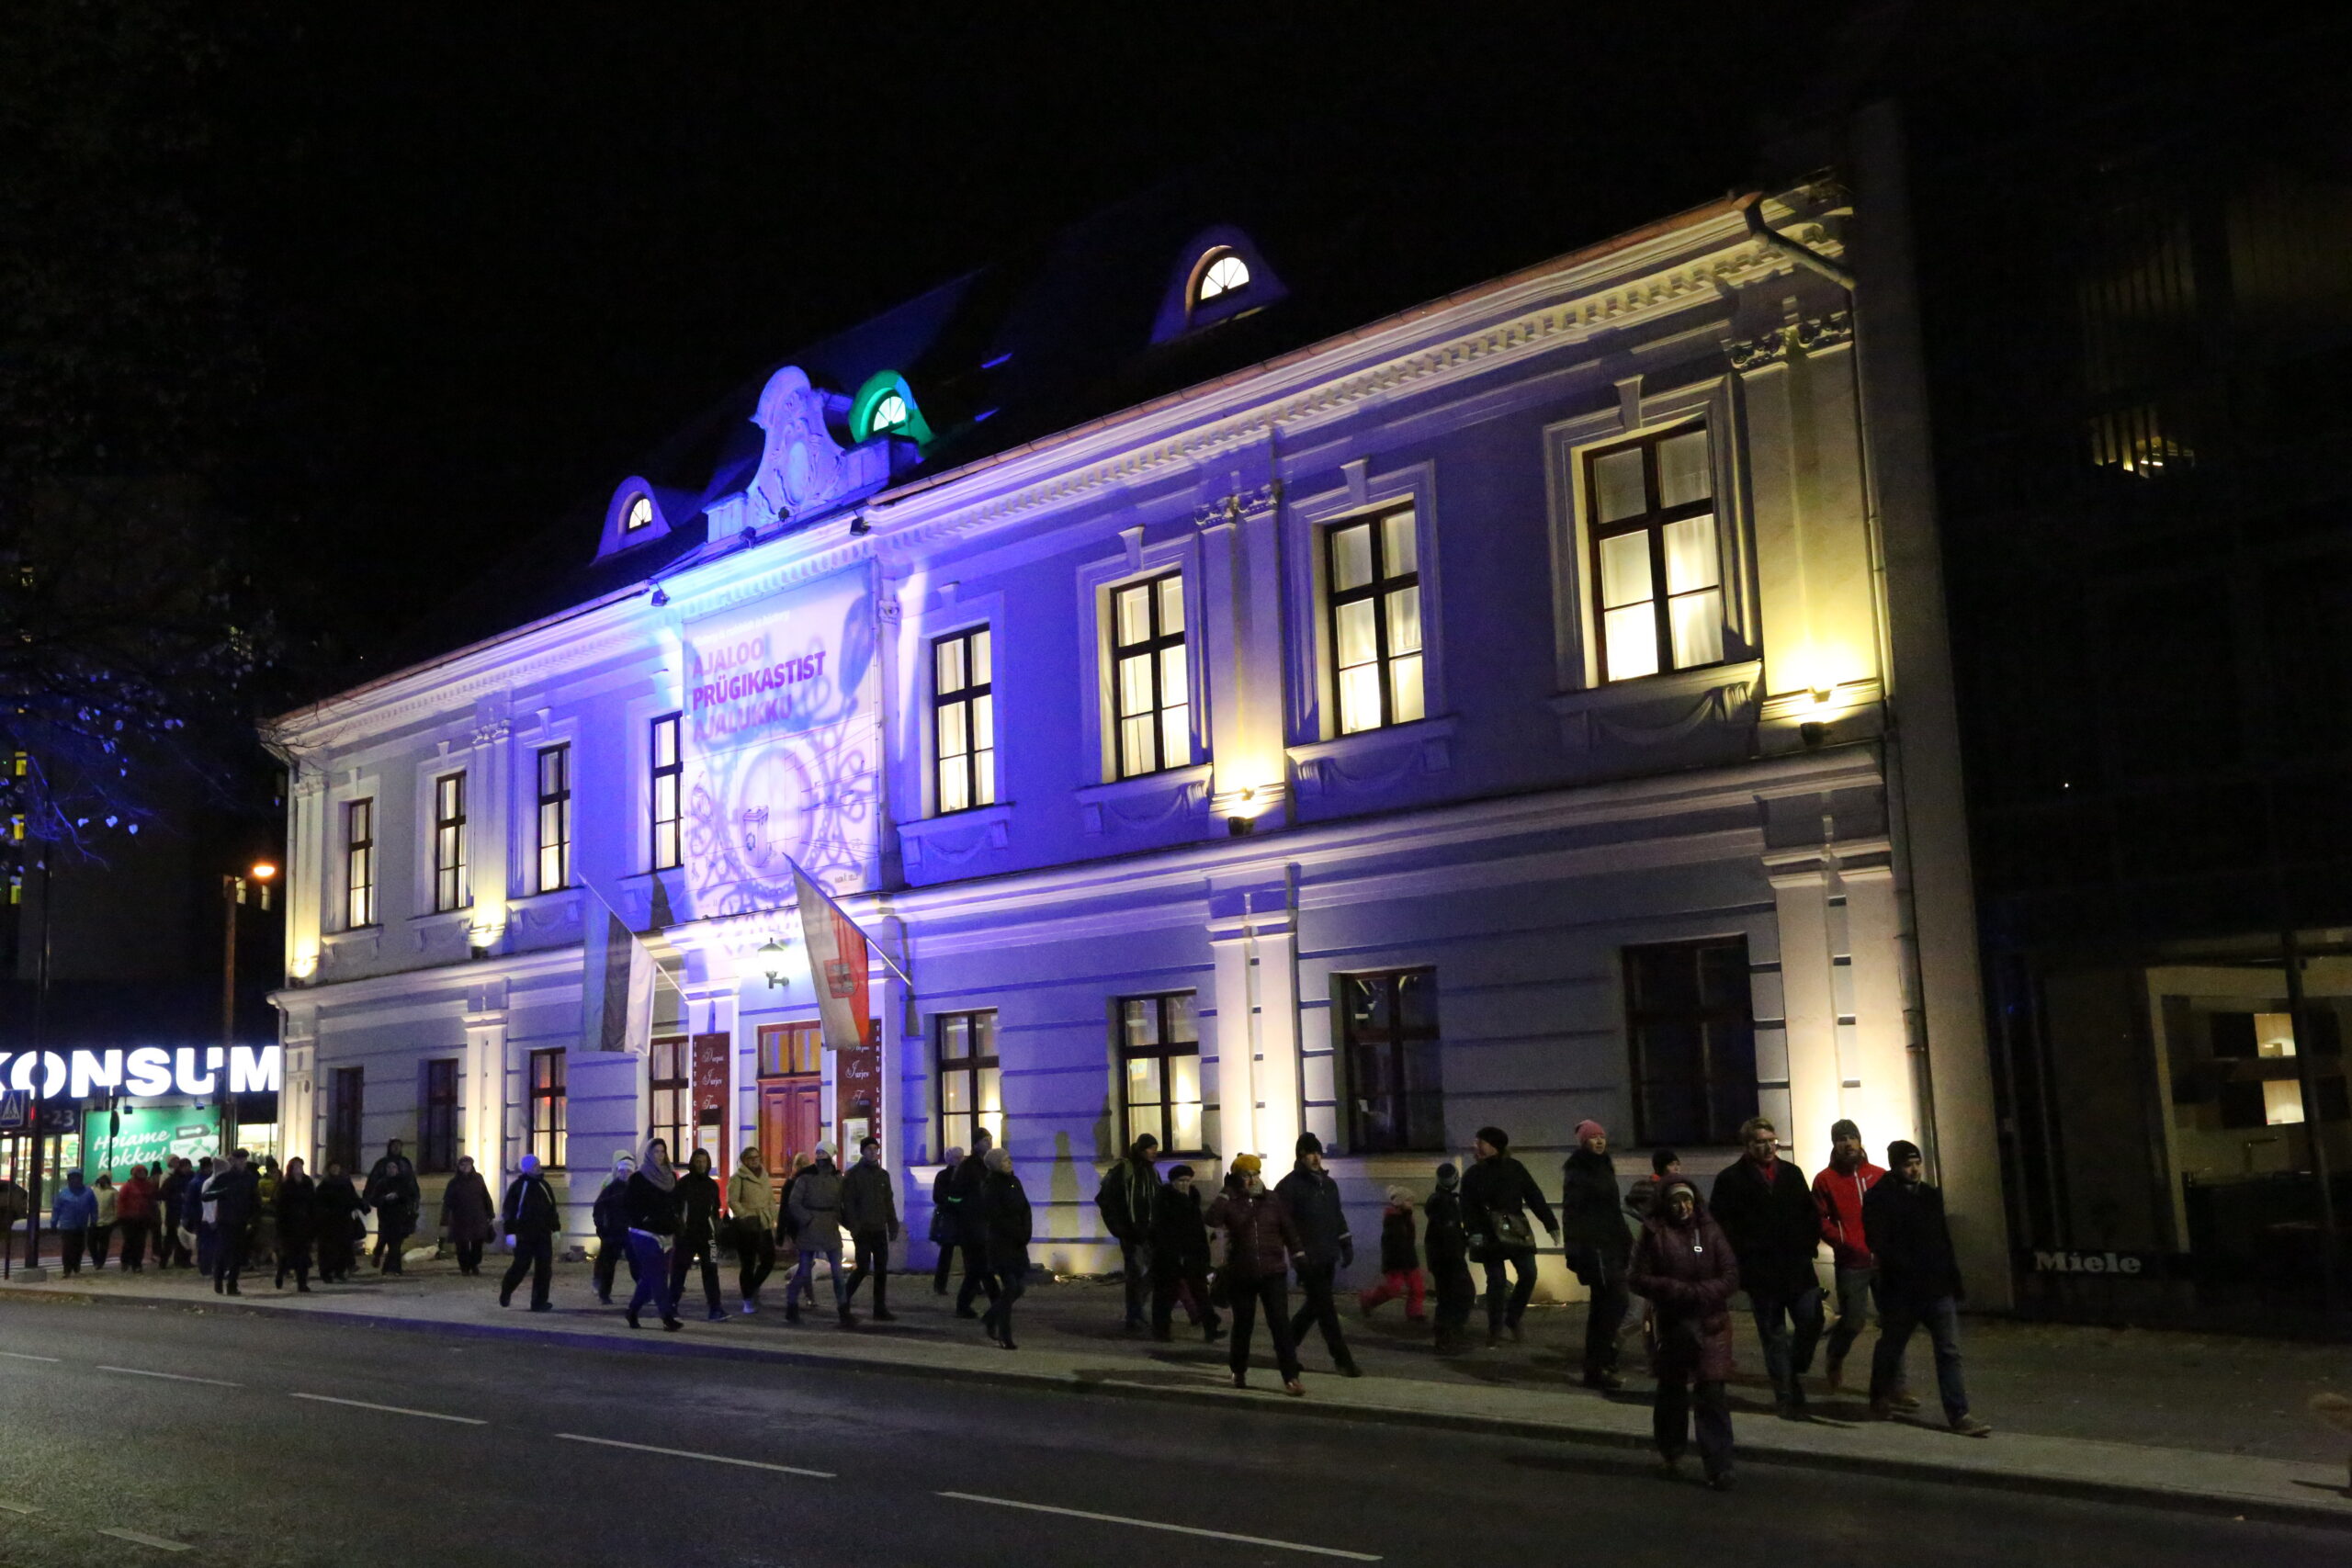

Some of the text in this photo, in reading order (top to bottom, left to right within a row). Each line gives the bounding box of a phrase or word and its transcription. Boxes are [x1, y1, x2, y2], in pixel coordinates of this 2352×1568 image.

[693, 637, 765, 680] AJALOO
[693, 650, 827, 711] PRÜGIKASTIST
[693, 694, 793, 743] AJALUKKU
[0, 1046, 280, 1100] ONSUM
[94, 1130, 171, 1152] Hoiame
[97, 1145, 167, 1169] kokku!
[2033, 1251, 2143, 1274] Miele
